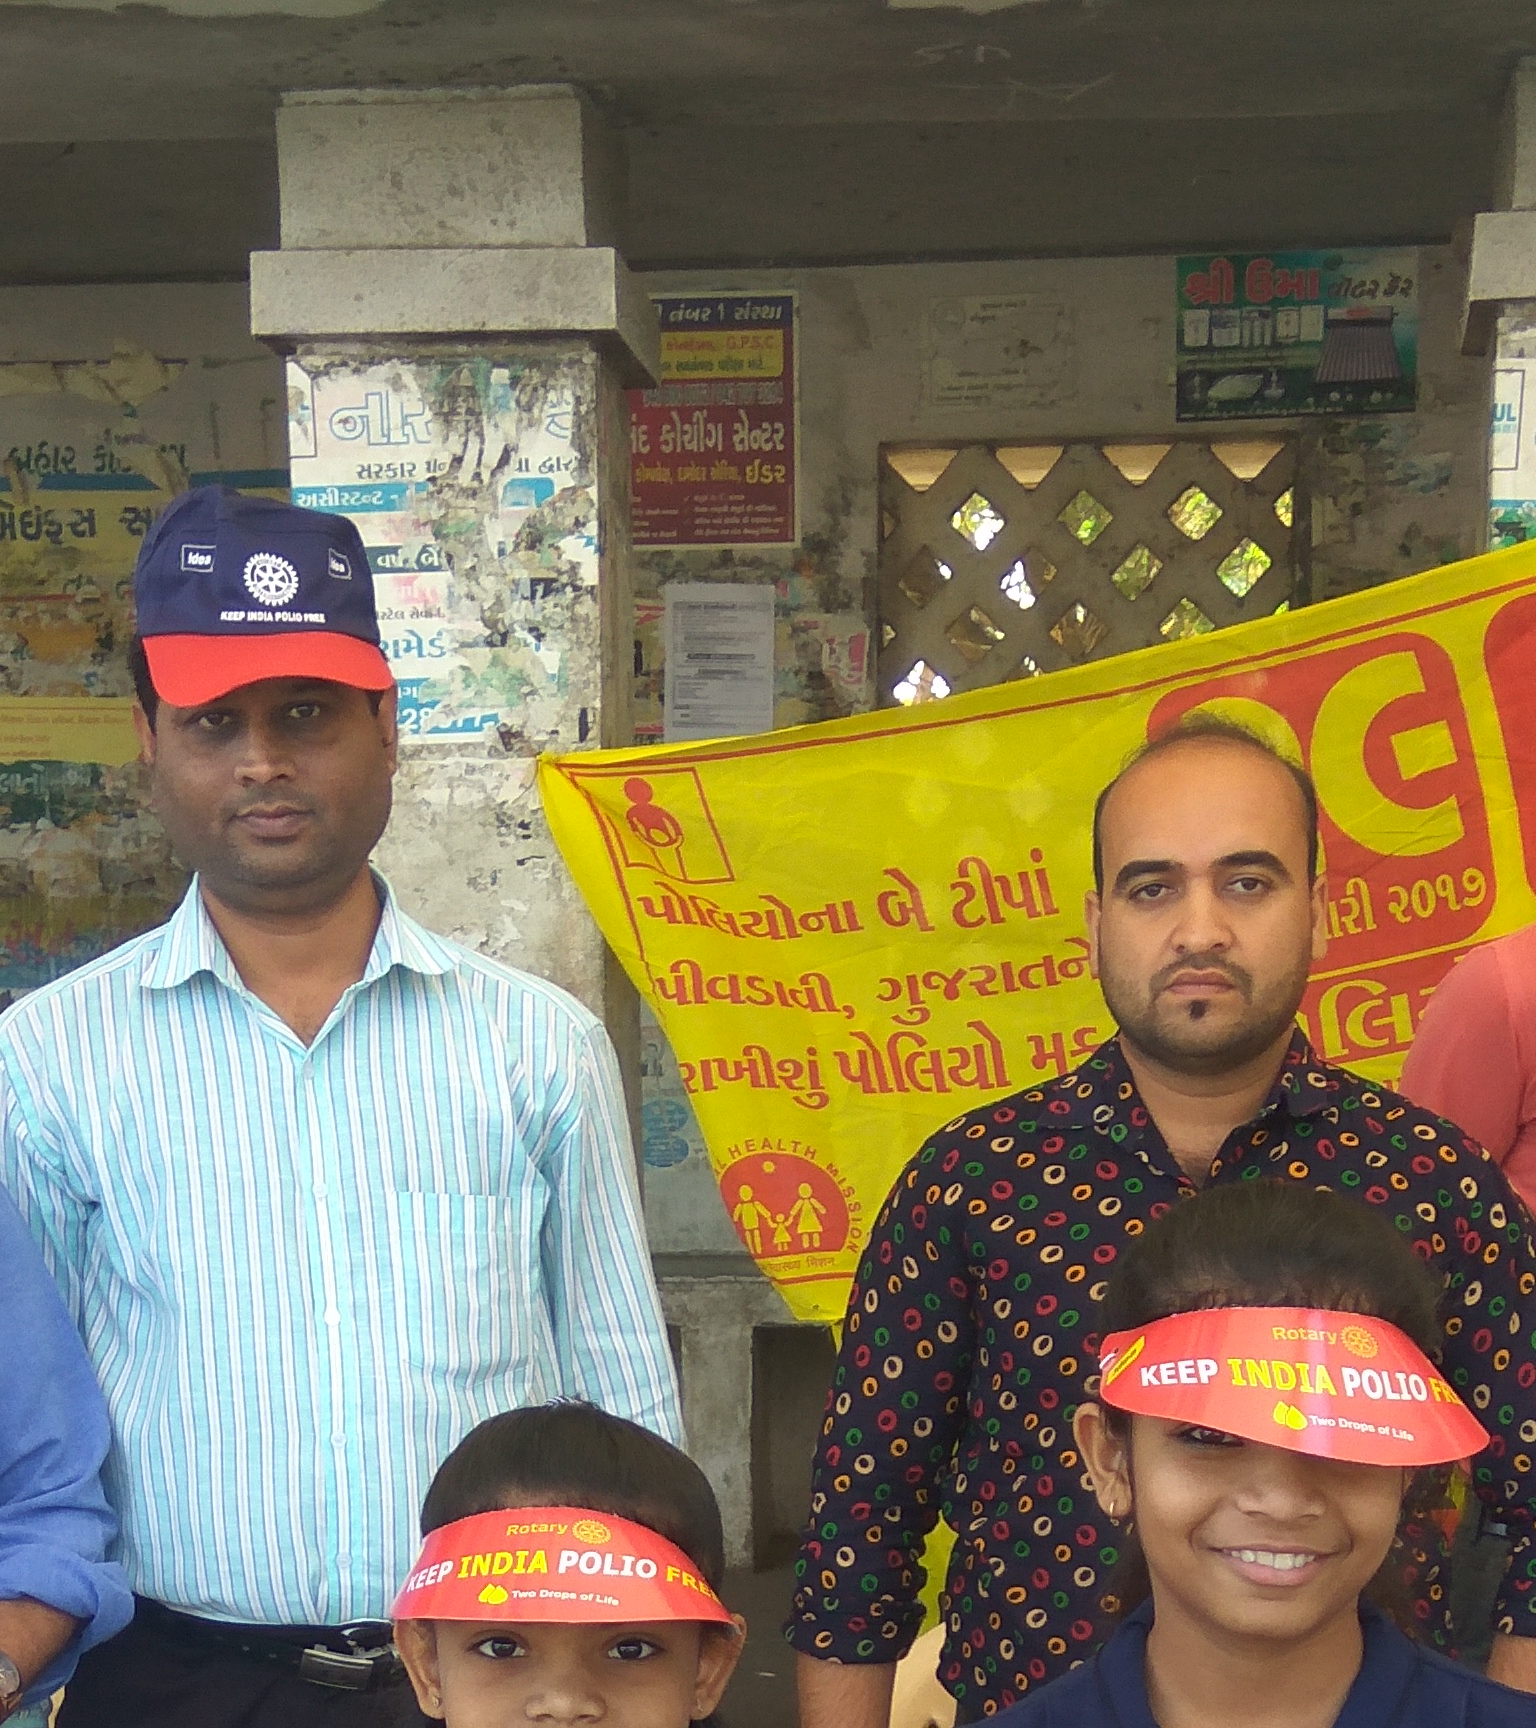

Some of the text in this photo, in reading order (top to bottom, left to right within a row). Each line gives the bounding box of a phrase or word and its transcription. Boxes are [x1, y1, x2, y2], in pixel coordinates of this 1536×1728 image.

[220, 610, 327, 624] KEEP INDIA POLIO FREE
[636, 847, 1060, 941] પોલિયોના બે ટીપાં
[1388, 866, 1488, 926] ૨૦૧૭
[832, 1020, 1013, 1094] પોલિયો
[727, 1137, 863, 1254] HEALTH MISSION
[1272, 1326, 1338, 1345] Rotary
[1140, 1358, 1219, 1387] KEEP
[1227, 1358, 1338, 1397] INDIA
[1341, 1366, 1428, 1402] POLIO
[1309, 1414, 1415, 1442] Two Drops of Life
[506, 1521, 568, 1537] Rotary
[407, 1560, 454, 1593] KEEP
[457, 1550, 549, 1579] INDIA
[558, 1550, 658, 1580] POLIO
[511, 1589, 620, 1606] Two Drops of Life
